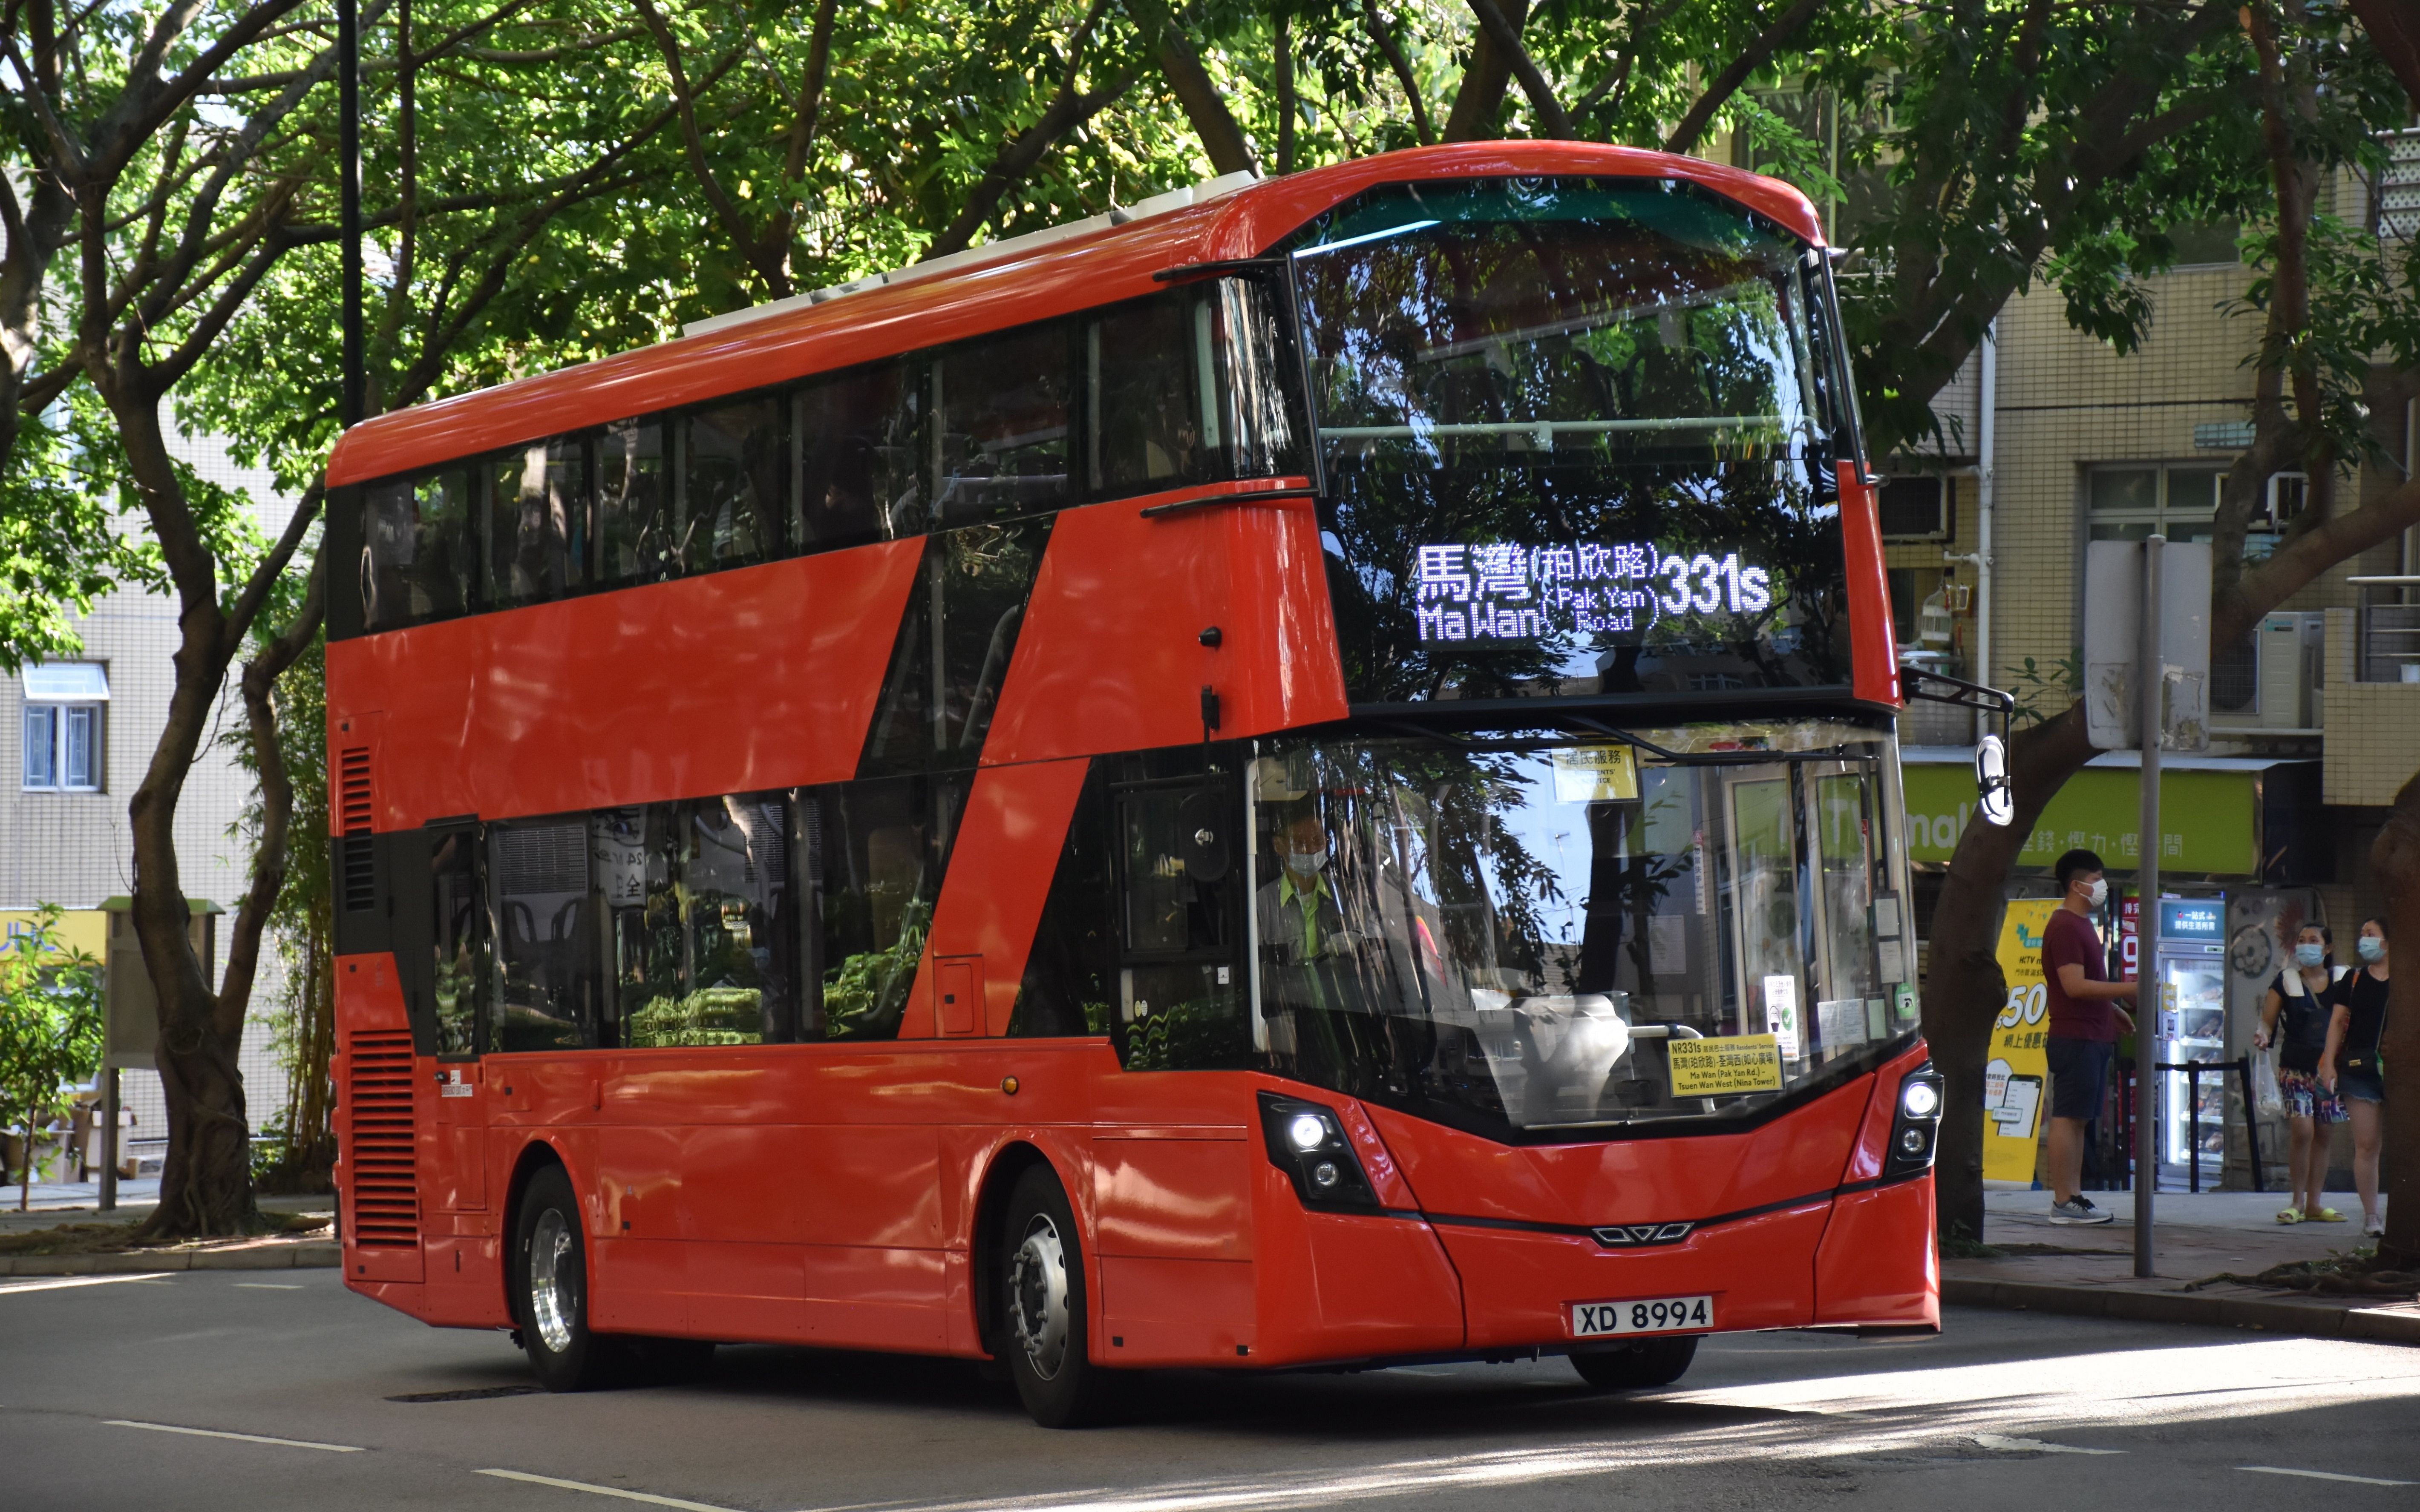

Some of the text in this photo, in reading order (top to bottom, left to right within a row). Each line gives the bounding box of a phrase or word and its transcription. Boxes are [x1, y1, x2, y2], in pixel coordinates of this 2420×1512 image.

[1418, 543, 1530, 602] 馬灣
[1659, 553, 1770, 615] 331s
[1418, 601, 1541, 641] Ma Wan
[1567, 750, 1621, 765] 居民服務
[2185, 911, 2205, 920] 一站式
[1672, 1042, 1701, 1054] NR331s
[1703, 1044, 1736, 1053] 居民巴士服務
[1718, 1069, 1731, 1079] (Pak
[1747, 1066, 1760, 1077] Rd.)
[1678, 1082, 1698, 1090] Tsuen
[1734, 1078, 1752, 1088] (Nina
[1753, 1076, 1775, 1086] Tower)
[1581, 1299, 1707, 1333] XD 8994
